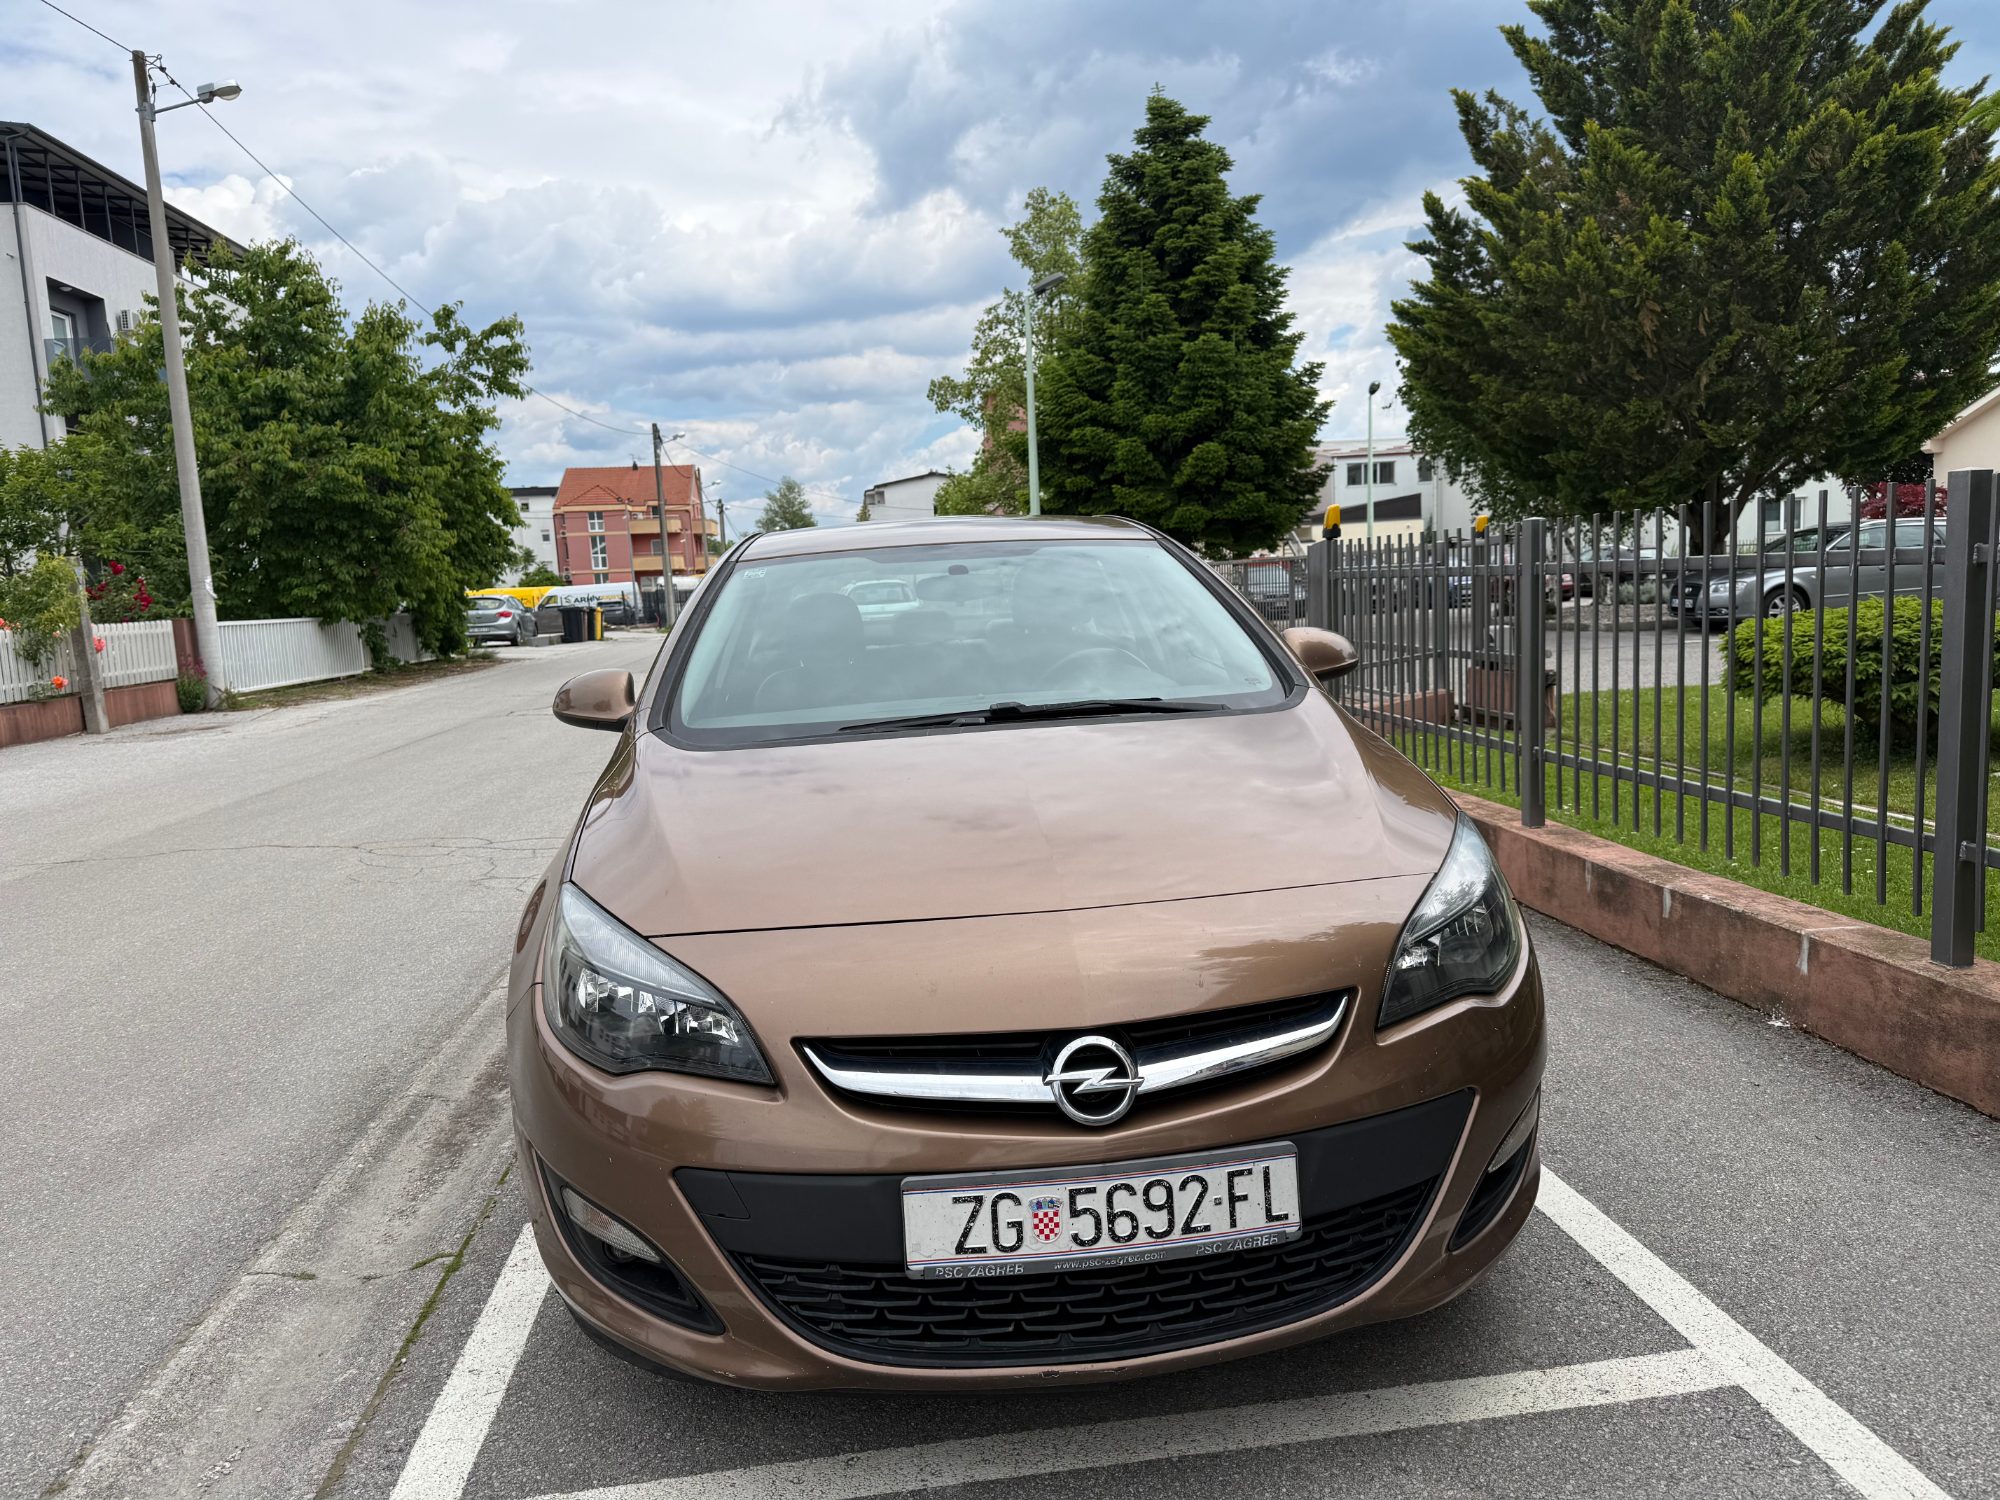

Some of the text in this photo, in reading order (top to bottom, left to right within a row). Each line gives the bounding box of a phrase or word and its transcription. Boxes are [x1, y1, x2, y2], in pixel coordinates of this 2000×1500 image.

[952, 1192, 1024, 1255] ZG
[1195, 1233, 1279, 1255] PSC ZAGREB
[936, 1263, 1025, 1279] PSC ZAGREB
